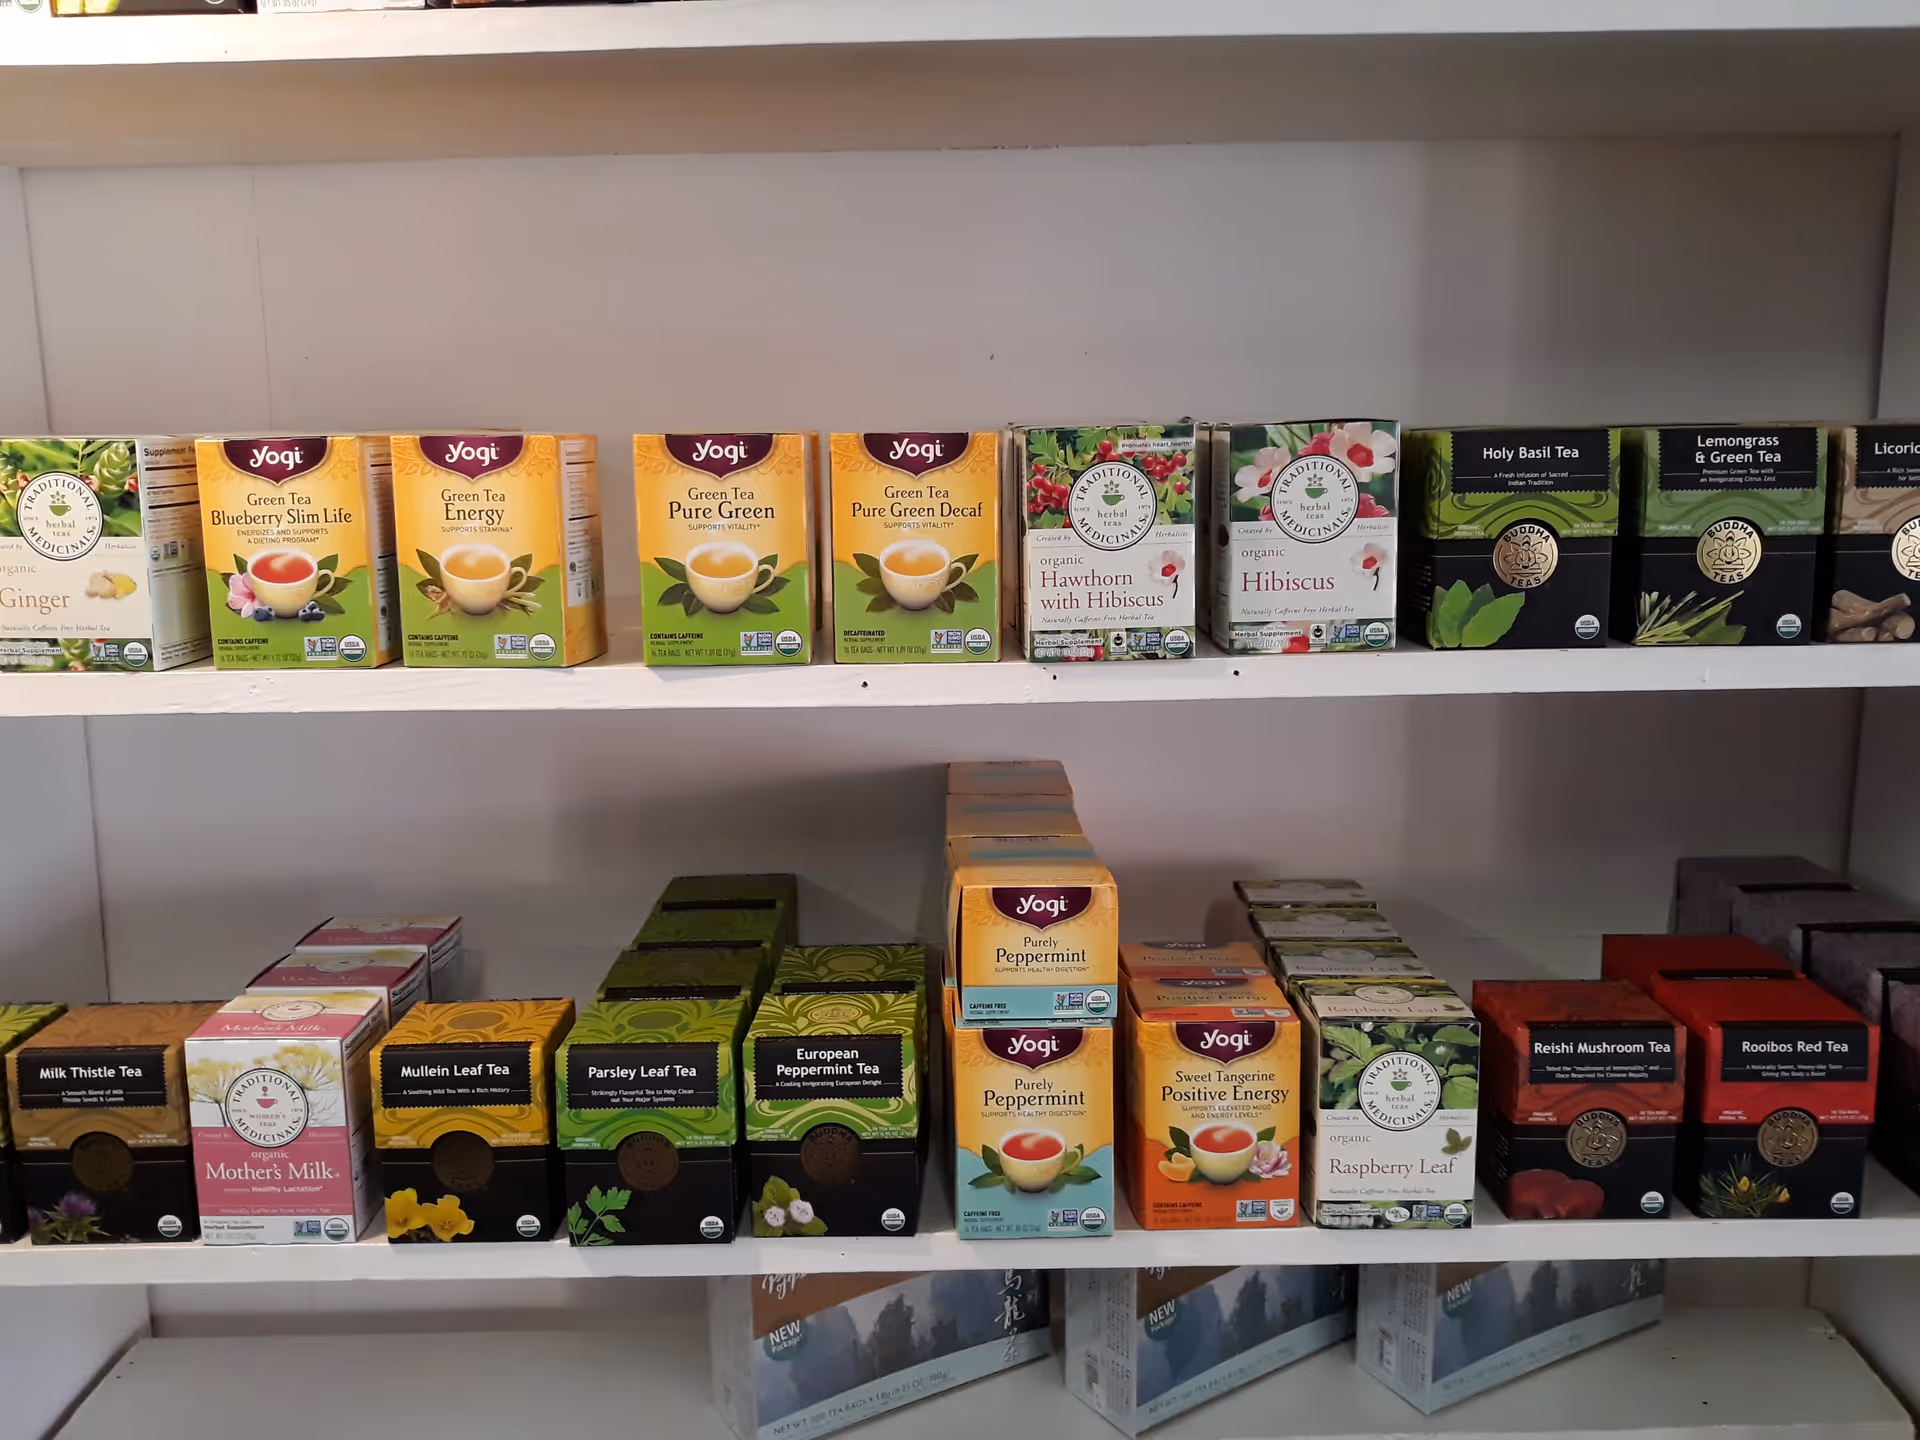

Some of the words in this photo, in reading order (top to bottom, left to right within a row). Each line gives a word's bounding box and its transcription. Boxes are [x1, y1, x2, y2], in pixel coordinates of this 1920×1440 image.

[1697, 435, 1780, 448] Lemongrass
[1875, 442, 1920, 454] Licoric
[1483, 447, 1514, 462] Holy
[1519, 447, 1551, 459] Basil
[1555, 446, 1579, 458] Tea
[1695, 452, 1705, 464] &
[1710, 451, 1753, 463] Green
[1757, 450, 1781, 463] Tea
[1076, 468, 1149, 501] TRADITIONAL
[1279, 461, 1352, 495] TRADITIONAL
[24, 478, 91, 511] TRADITIONAL
[247, 493, 285, 505] Green
[288, 493, 311, 504] Tea
[441, 489, 479, 502] Green
[483, 489, 505, 502] Tea
[688, 488, 728, 500] Green
[730, 488, 754, 500] Tea
[884, 486, 923, 498] Green
[927, 486, 949, 498] Tea
[444, 503, 504, 525] Energy
[669, 501, 712, 519] Pure
[718, 501, 775, 519] Green
[852, 502, 886, 518] Pure
[891, 502, 935, 517] Green
[940, 502, 983, 517] Decaf
[1300, 503, 1330, 511] herbal
[211, 510, 282, 530] Blueberry
[287, 508, 320, 524] Slim
[323, 508, 352, 524] Life
[1306, 512, 1324, 520] teas
[1503, 526, 1550, 543] BUDDHA
[1707, 521, 1754, 538] BUDDHA
[1040, 554, 1084, 568] organic
[1241, 547, 1285, 561] organic
[1041, 569, 1132, 588] Hawthorn
[1242, 571, 1335, 592] Hibiscus
[1511, 577, 1541, 587] TEAS
[0, 588, 69, 615] Ginger
[1041, 592, 1080, 610] with
[1088, 591, 1164, 608] Hibiscus
[1024, 937, 1058, 949] Purely
[996, 948, 1086, 966] Peppermint
[1534, 1042, 1573, 1054] Reishi
[1577, 1042, 1644, 1053] Mushroom
[1648, 1041, 1671, 1053] Tea
[1742, 1041, 1793, 1053] Rooibos
[1798, 1041, 1822, 1052] Red
[1825, 1041, 1848, 1052] Tea
[797, 1049, 859, 1062] European
[40, 1068, 67, 1080] Milk
[70, 1067, 116, 1079] Thistle
[119, 1065, 142, 1077] Tea
[401, 1065, 449, 1077] Mullein
[454, 1064, 483, 1076] Leaf
[486, 1063, 510, 1075] Tea
[588, 1066, 636, 1080] Parsley
[641, 1065, 670, 1077] Leaf
[673, 1065, 697, 1077] Tea
[777, 1064, 853, 1078] Peppermint
[856, 1063, 880, 1075] Tea
[1176, 1071, 1211, 1083] Sweet
[1215, 1070, 1275, 1084] Tangerine
[1365, 1057, 1435, 1086] TRADITIONAL
[233, 1074, 301, 1103] TRADITIONAL
[1015, 1079, 1054, 1092] Purely
[984, 1090, 1085, 1110] Peppermint
[1162, 1086, 1227, 1102] Positive
[1233, 1085, 1289, 1104] Energy
[1385, 1094, 1415, 1102] herbal
[1330, 1134, 1371, 1144] organic
[252, 1151, 289, 1161] organic
[206, 1162, 282, 1180] Mother's
[1330, 1158, 1413, 1178] Raspberry
[1420, 1156, 1458, 1174] Leaf
[1447, 1278, 1472, 1302] NEW
[1149, 1299, 1175, 1325] NEW
[769, 1320, 800, 1346] NEW
